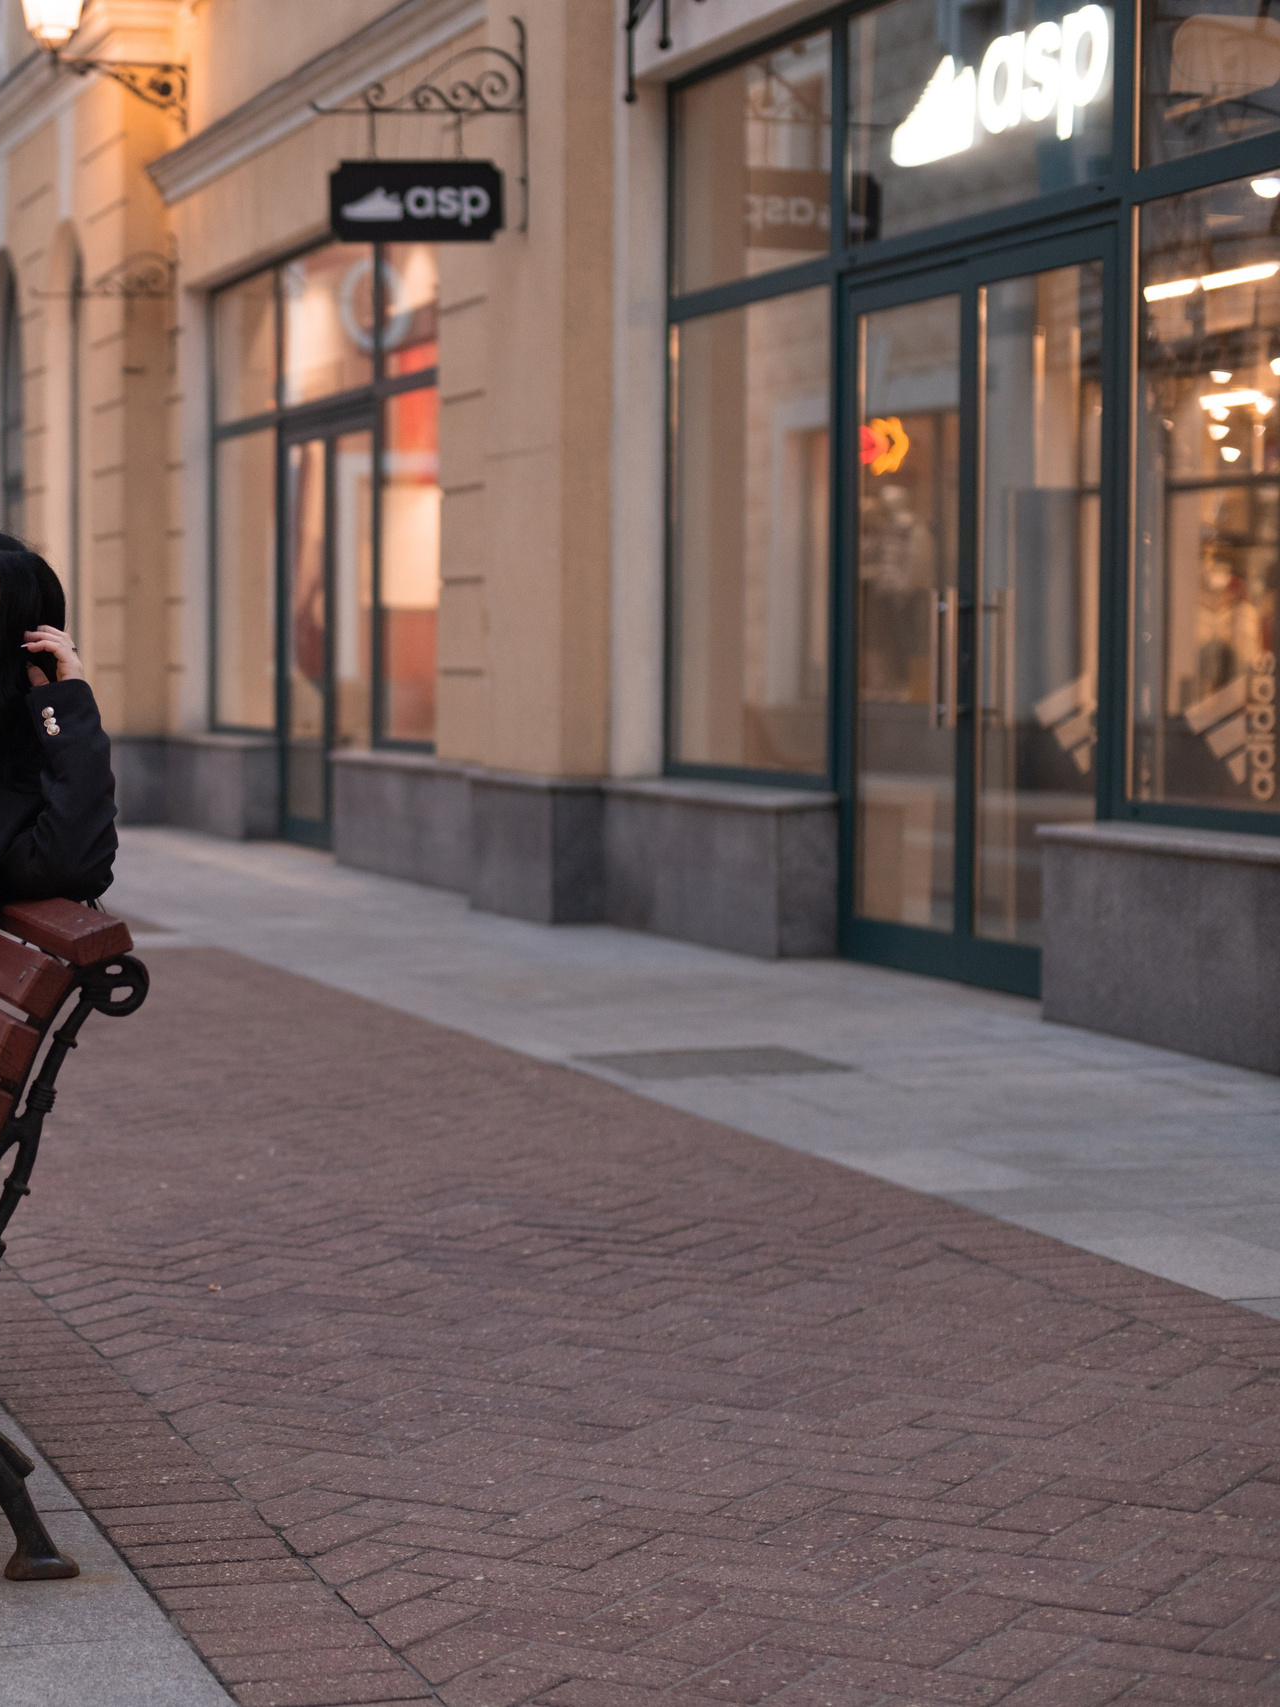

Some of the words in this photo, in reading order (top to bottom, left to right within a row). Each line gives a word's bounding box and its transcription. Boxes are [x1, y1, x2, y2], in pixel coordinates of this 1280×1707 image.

[977, 4, 1109, 141] asp
[404, 185, 491, 227] asp
[1246, 651, 1276, 801] adidas
